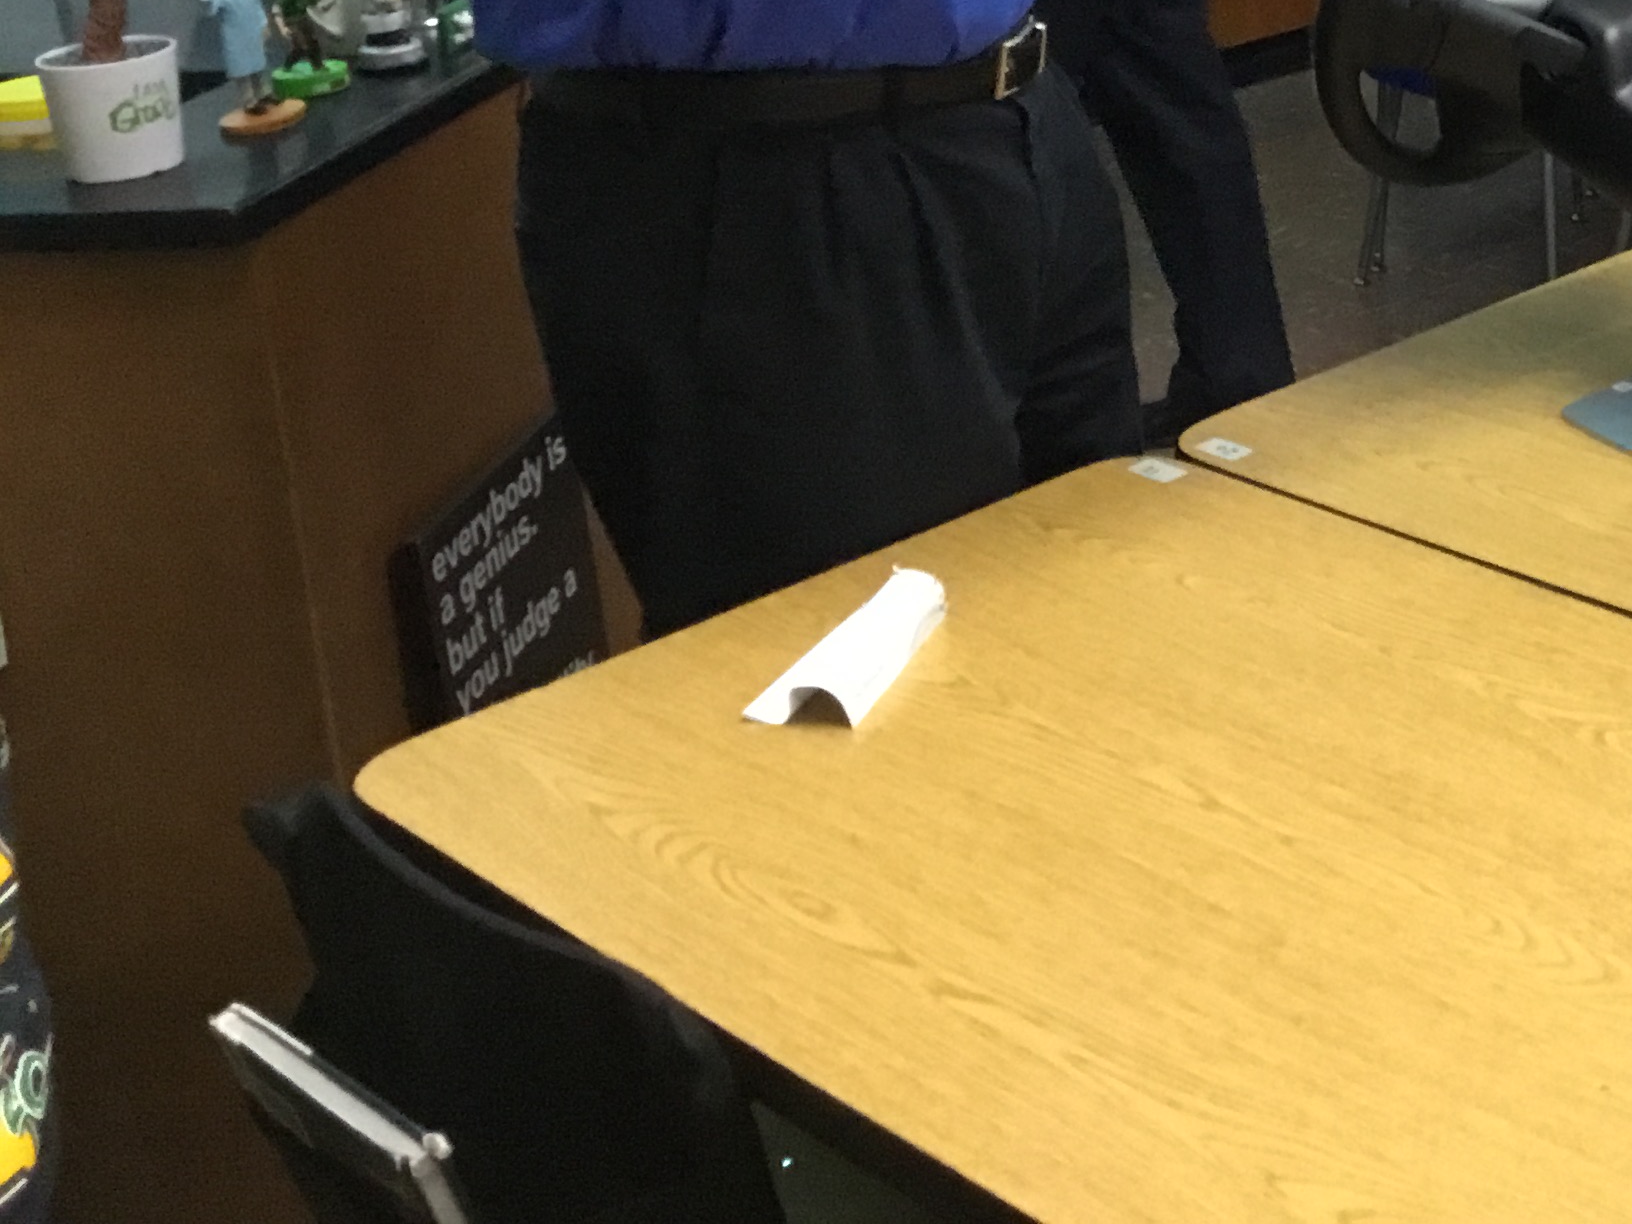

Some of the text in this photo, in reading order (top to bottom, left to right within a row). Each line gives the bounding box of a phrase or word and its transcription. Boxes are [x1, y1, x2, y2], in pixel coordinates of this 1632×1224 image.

[432, 435, 567, 582] everybody is
[440, 514, 539, 625] a genius.
[446, 586, 504, 676] but if
[456, 566, 577, 716] you judge a
